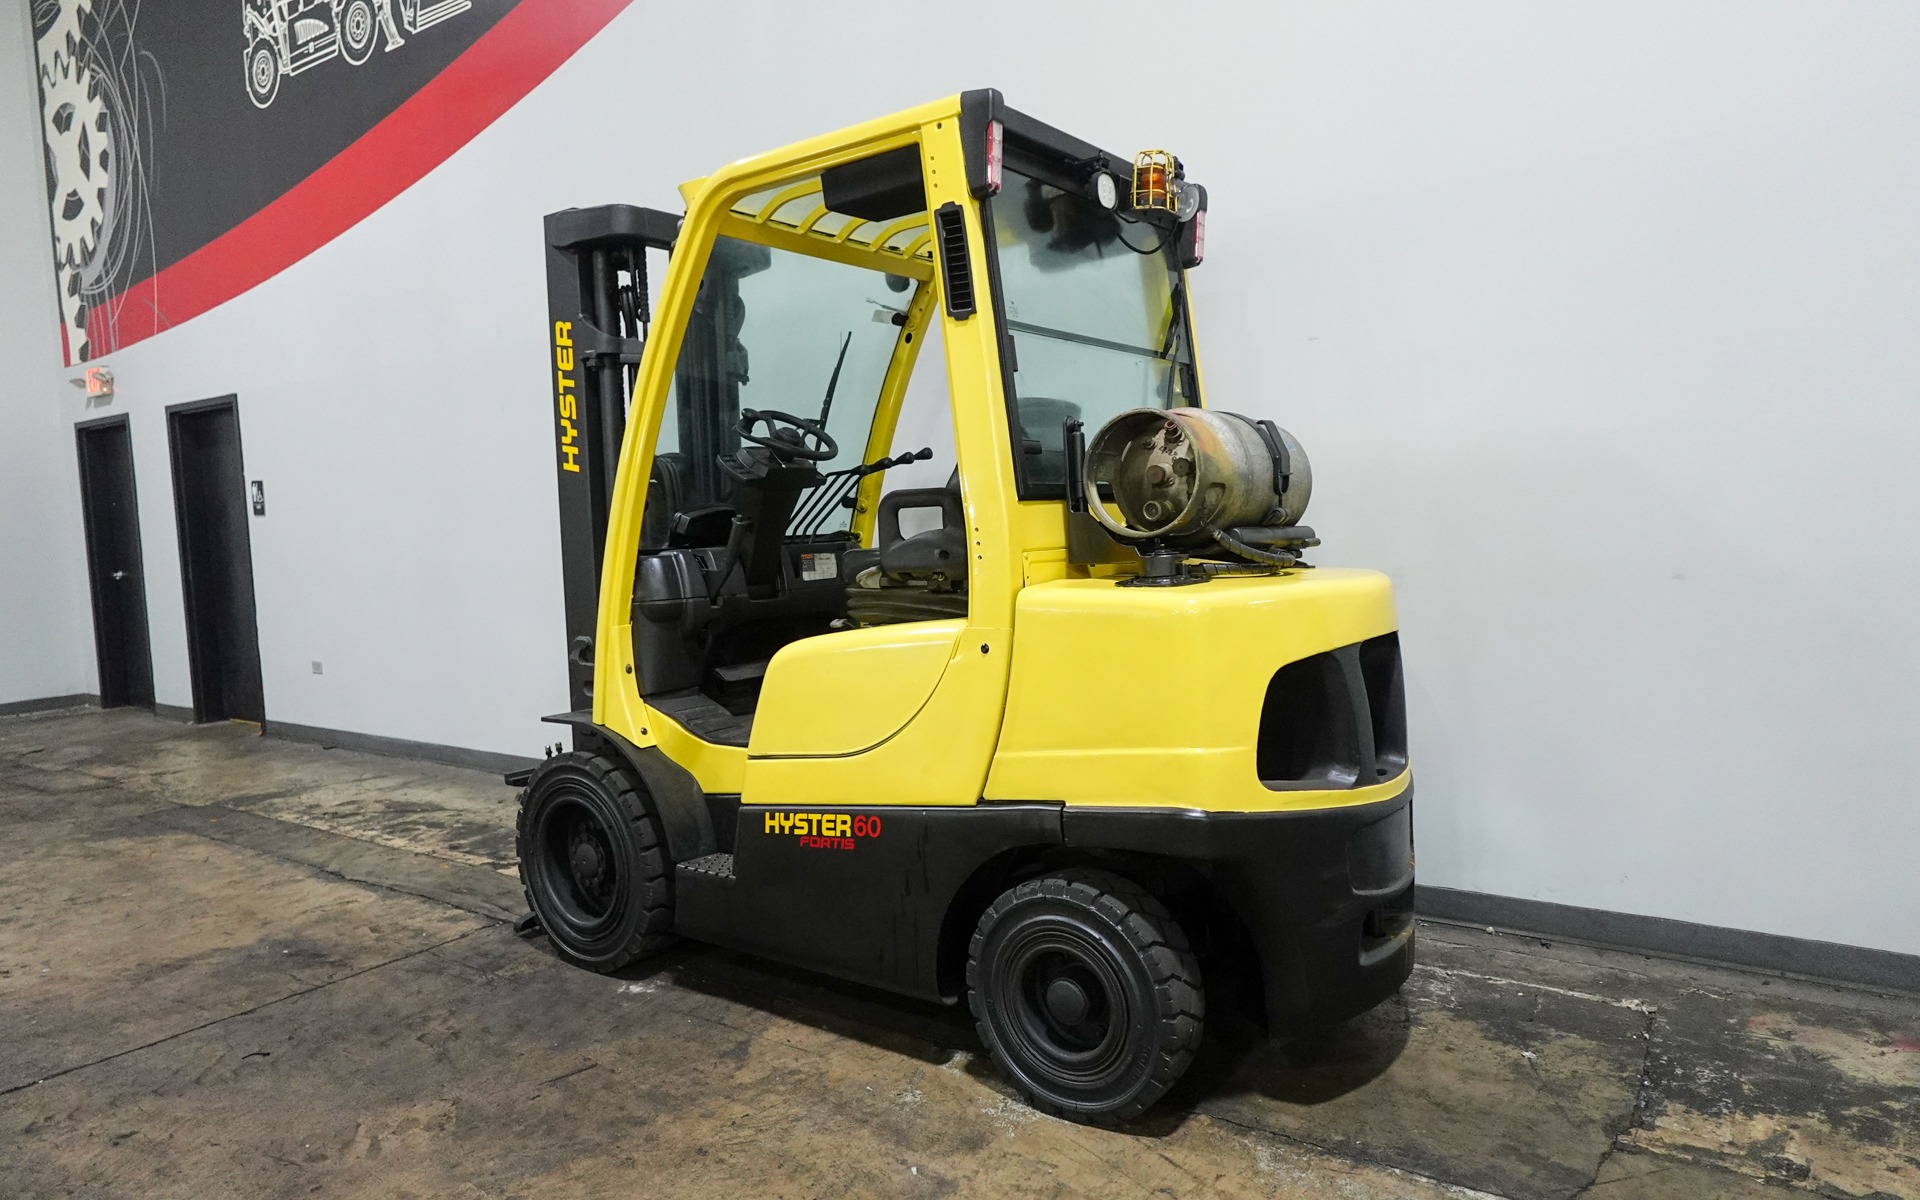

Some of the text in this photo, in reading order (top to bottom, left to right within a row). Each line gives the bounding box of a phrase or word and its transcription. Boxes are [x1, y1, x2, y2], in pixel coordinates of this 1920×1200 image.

[555, 320, 580, 473] HYSTER
[764, 811, 881, 838] HYSTER 60
[799, 835, 855, 850] FORTIS
